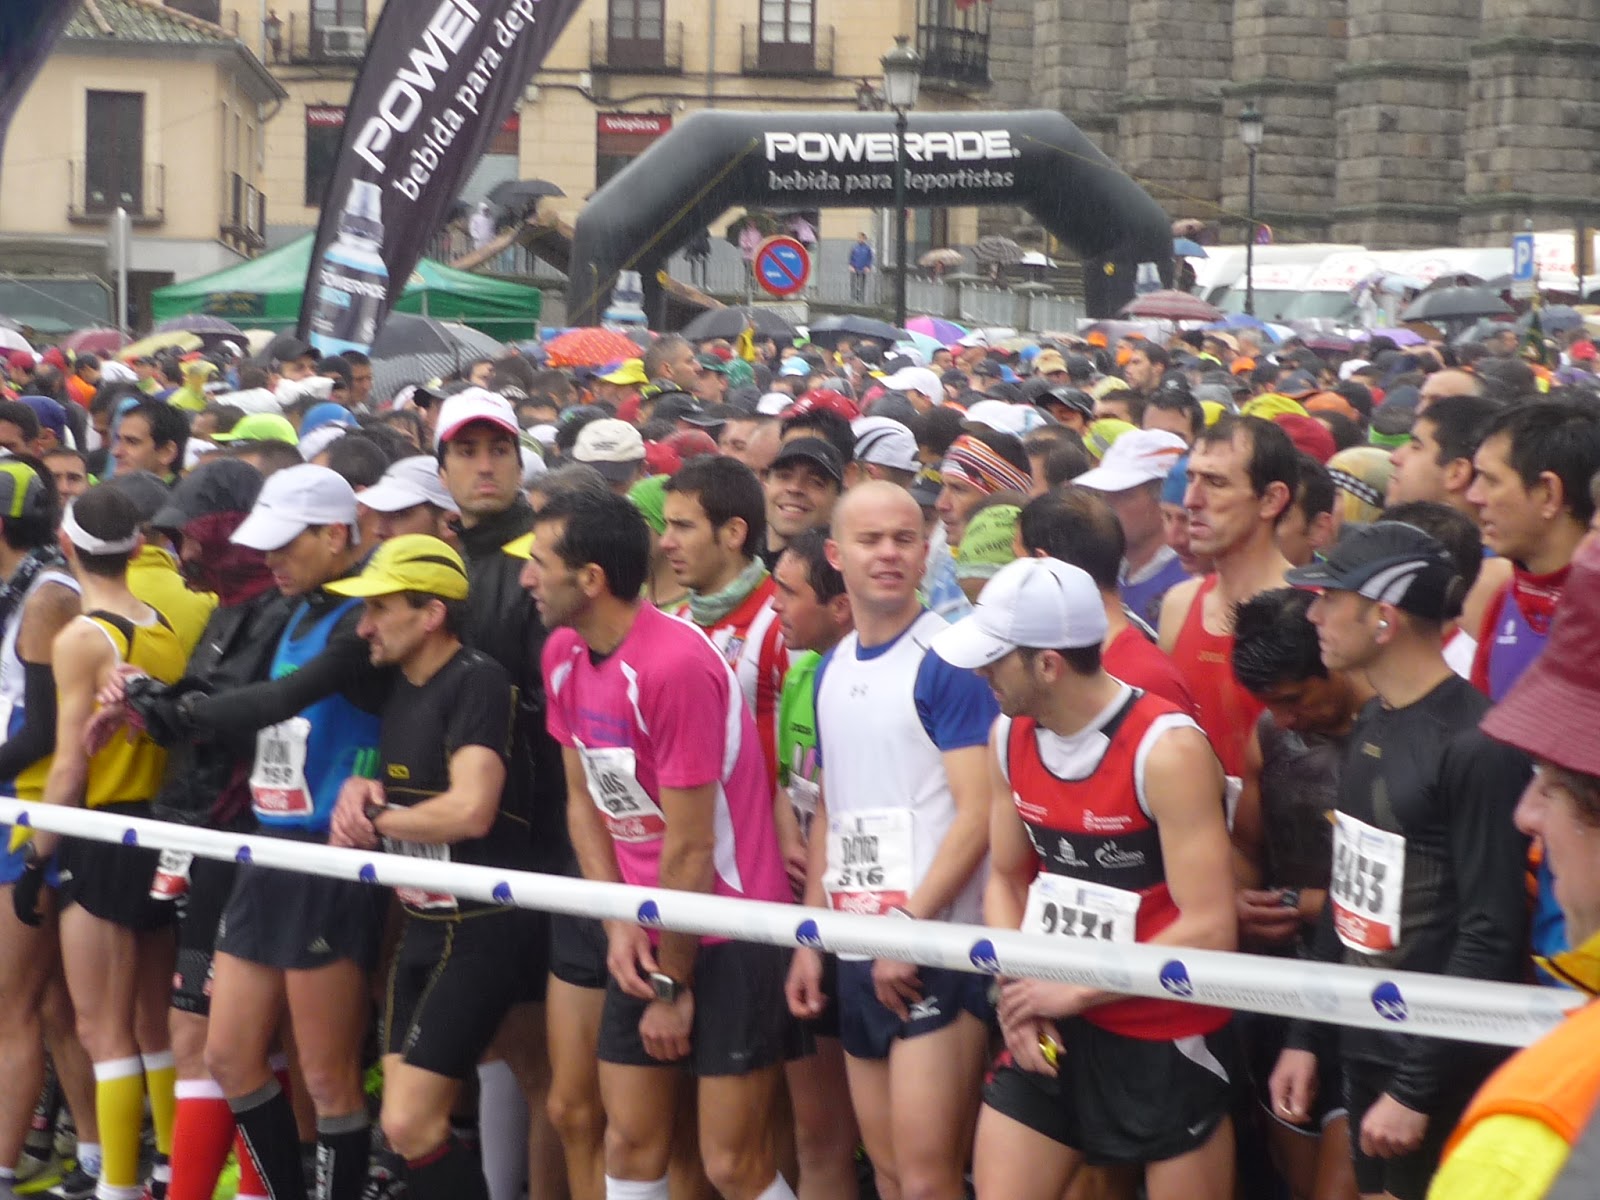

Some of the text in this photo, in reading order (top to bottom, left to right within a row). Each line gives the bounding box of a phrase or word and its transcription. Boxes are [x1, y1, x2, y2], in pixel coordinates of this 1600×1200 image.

[391, 0, 541, 202] bebida para dep
[768, 169, 841, 191] bebida
[844, 172, 893, 194] para
